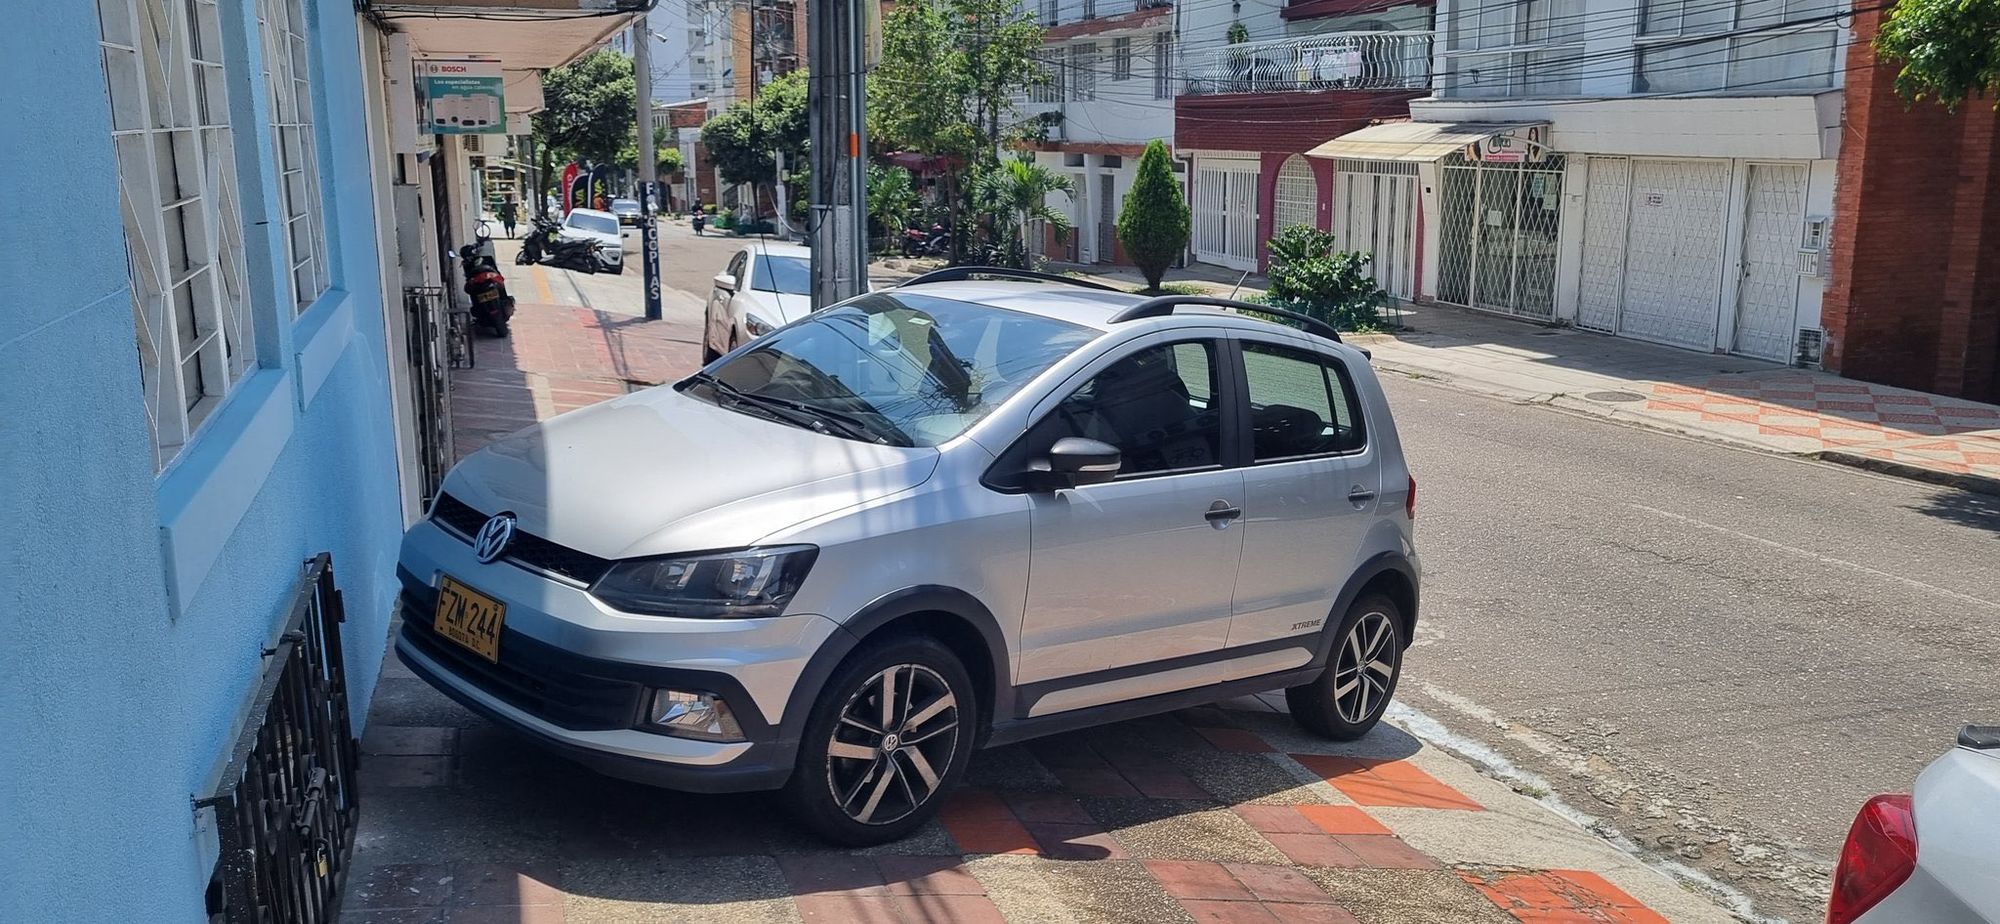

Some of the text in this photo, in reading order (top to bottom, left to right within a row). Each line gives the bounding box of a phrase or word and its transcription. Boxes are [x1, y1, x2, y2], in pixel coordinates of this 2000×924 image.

[441, 65, 467, 73] BOSCH
[437, 587, 498, 645] FZM 244
[1291, 619, 1322, 631] XTREME
